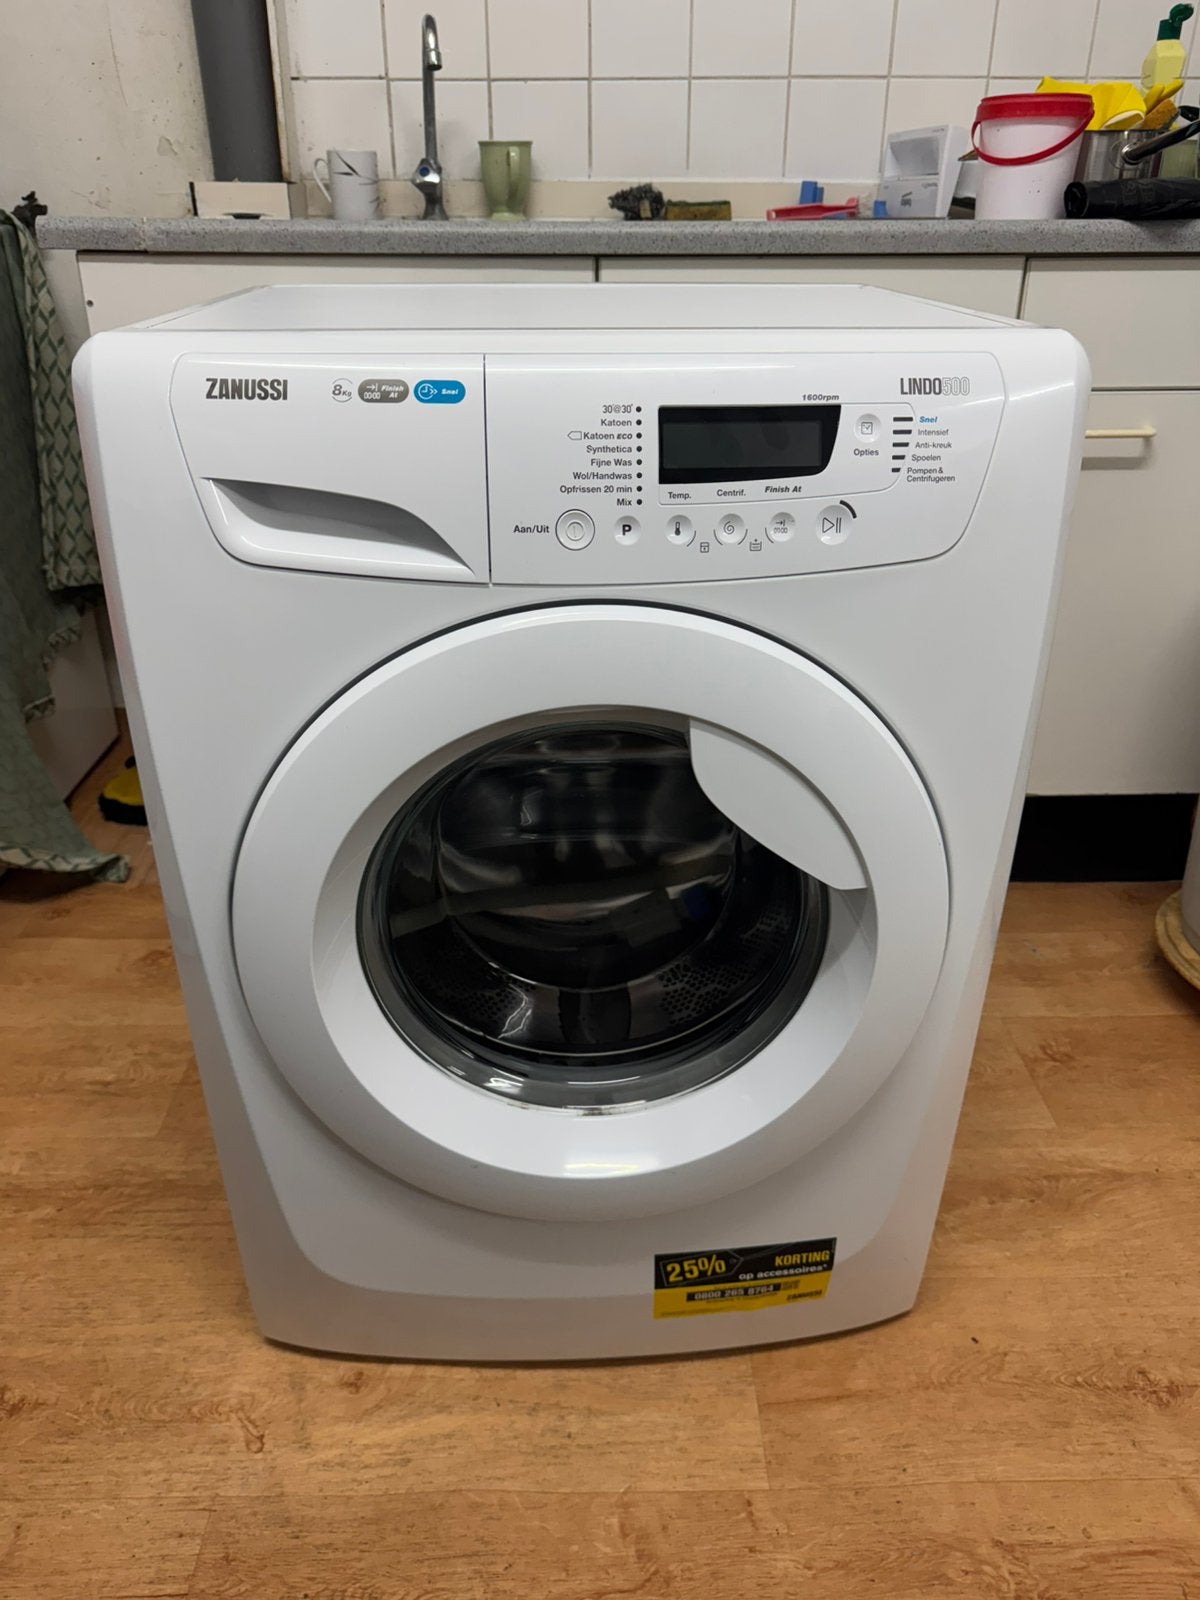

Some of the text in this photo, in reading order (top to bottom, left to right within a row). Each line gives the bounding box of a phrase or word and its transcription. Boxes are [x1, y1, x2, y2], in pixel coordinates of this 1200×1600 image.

[205, 378, 288, 400] ZANUSSI
[801, 393, 840, 401] 1600rpm
[600, 419, 632, 427] Katoen
[919, 415, 938, 423] Snel
[583, 432, 615, 440] Katoen
[917, 428, 949, 436] Intensief
[586, 444, 633, 455] Synthetica
[915, 441, 952, 449] Anti-kreuk
[853, 448, 880, 457] Opties
[590, 458, 633, 468] Fijne Was
[911, 454, 942, 463] Spoelen
[572, 471, 633, 480] Wol/Handwas
[906, 467, 937, 476] Pompen
[906, 475, 956, 484] Centrifugeren
[560, 485, 633, 495] Opfrissen 20 min
[716, 488, 747, 497] Centrif.
[764, 485, 802, 494] Finish At
[668, 491, 692, 500] Temp.
[616, 498, 633, 506] Mix
[513, 524, 550, 534] Aan/Uit
[622, 523, 632, 536] P
[774, 1250, 830, 1267] KORTING
[667, 1254, 726, 1282] 25%
[738, 1272, 755, 1281] op
[694, 1290, 722, 1301] 0800
[747, 1282, 775, 1295] 8764
